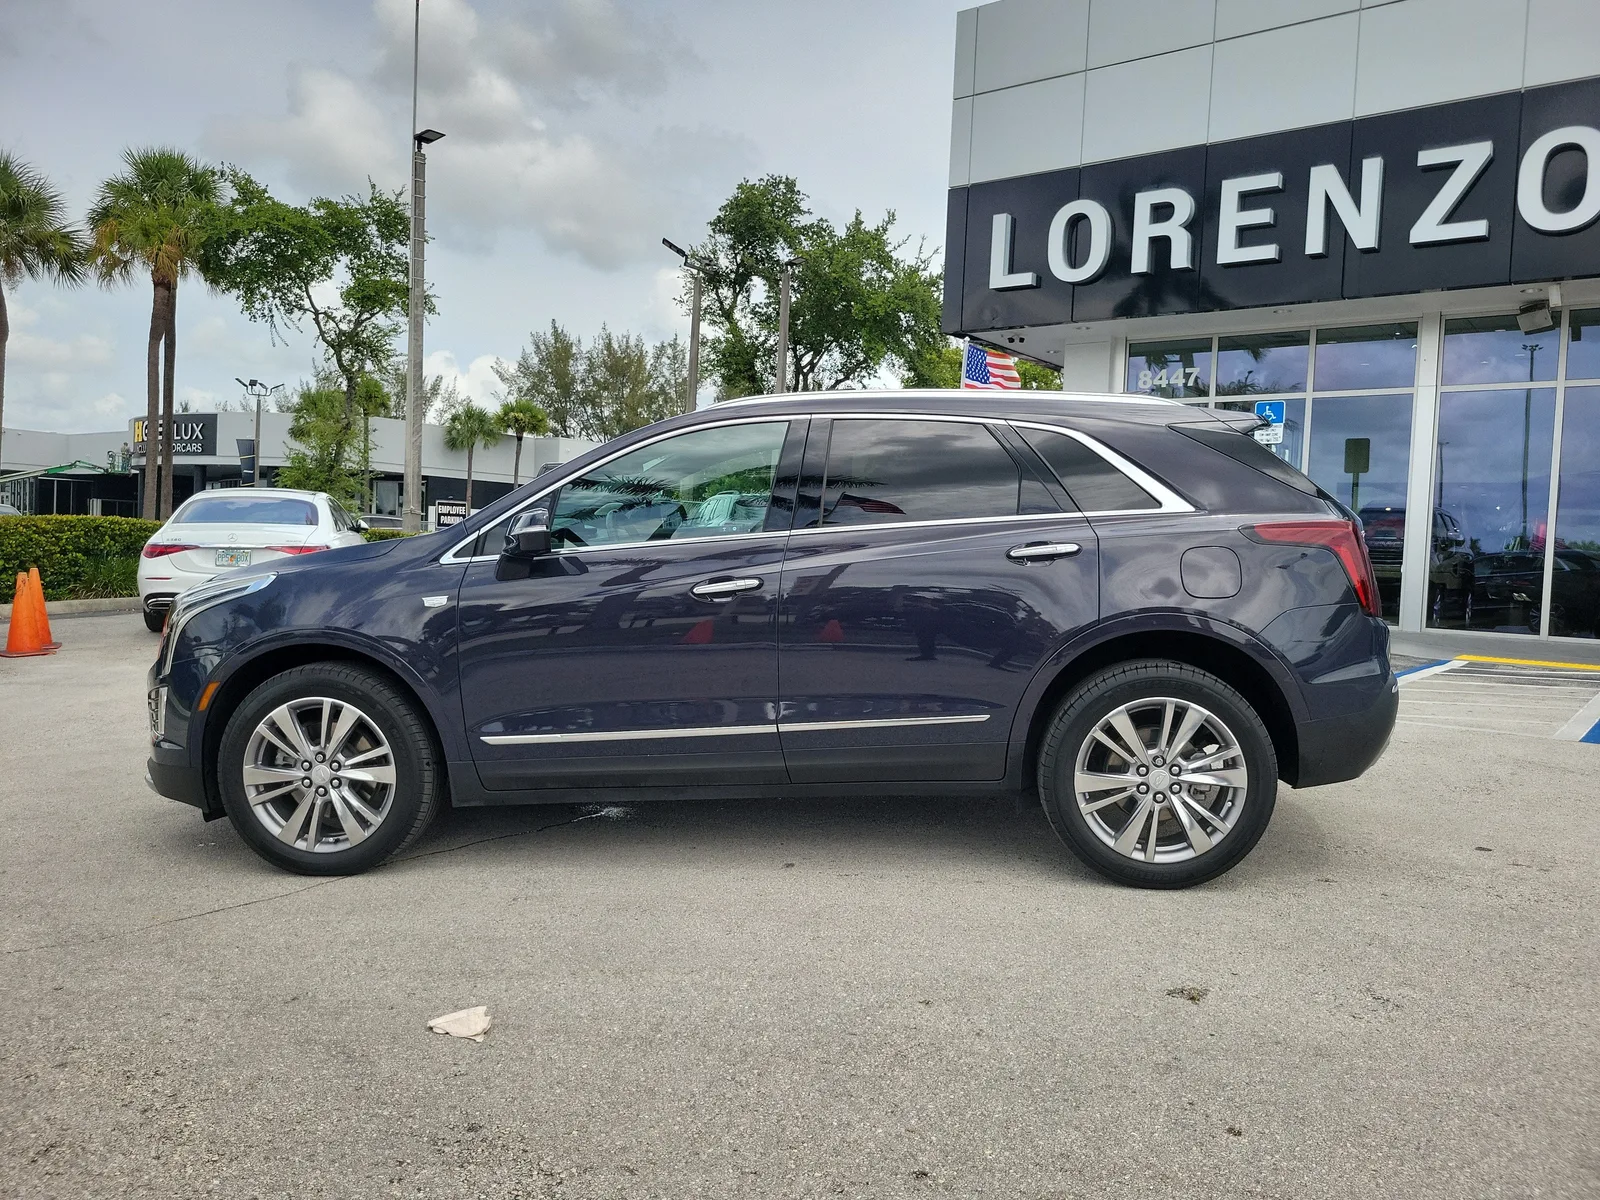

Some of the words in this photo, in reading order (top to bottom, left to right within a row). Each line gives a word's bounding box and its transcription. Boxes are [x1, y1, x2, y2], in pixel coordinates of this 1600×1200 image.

[989, 125, 1600, 290] LORENZO
[1138, 367, 1200, 389] 8447
[438, 505, 466, 514] EMPLOYEE
